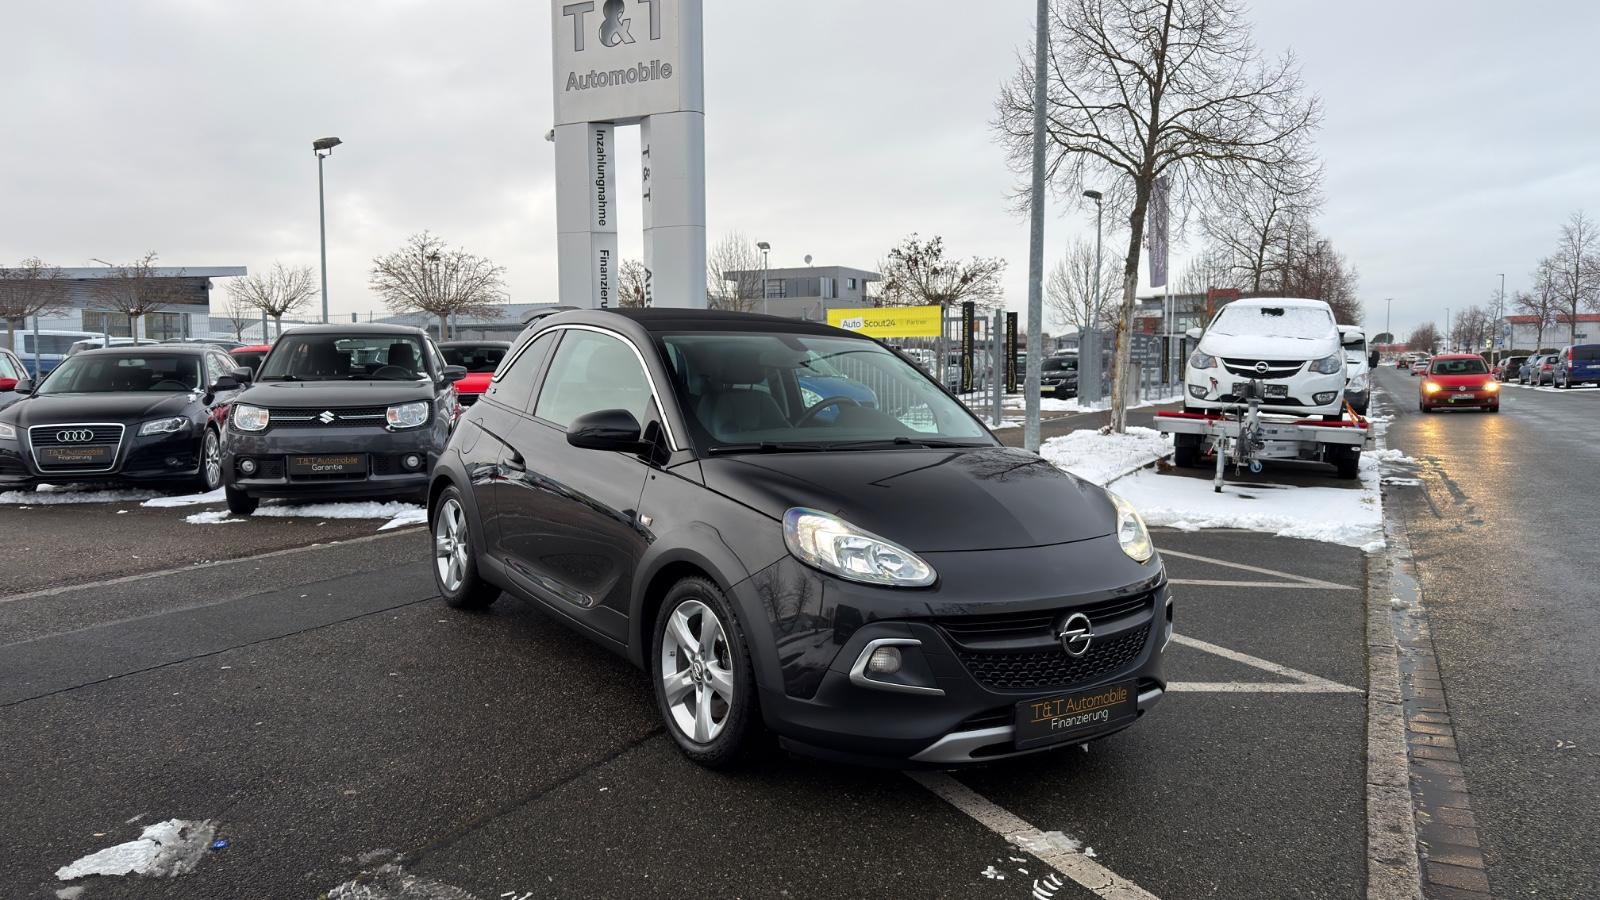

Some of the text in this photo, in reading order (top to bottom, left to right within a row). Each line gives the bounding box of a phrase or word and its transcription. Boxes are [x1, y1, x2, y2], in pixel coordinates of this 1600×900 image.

[563, 0, 661, 52] T&T
[566, 60, 673, 91] Automobile
[595, 129, 608, 227] Inzahlungnahme
[842, 320, 862, 328] Auto
[864, 319, 896, 328] Scout24
[1031, 687, 1128, 719] T&T Automobile
[1051, 709, 1109, 730] Finanzierung
